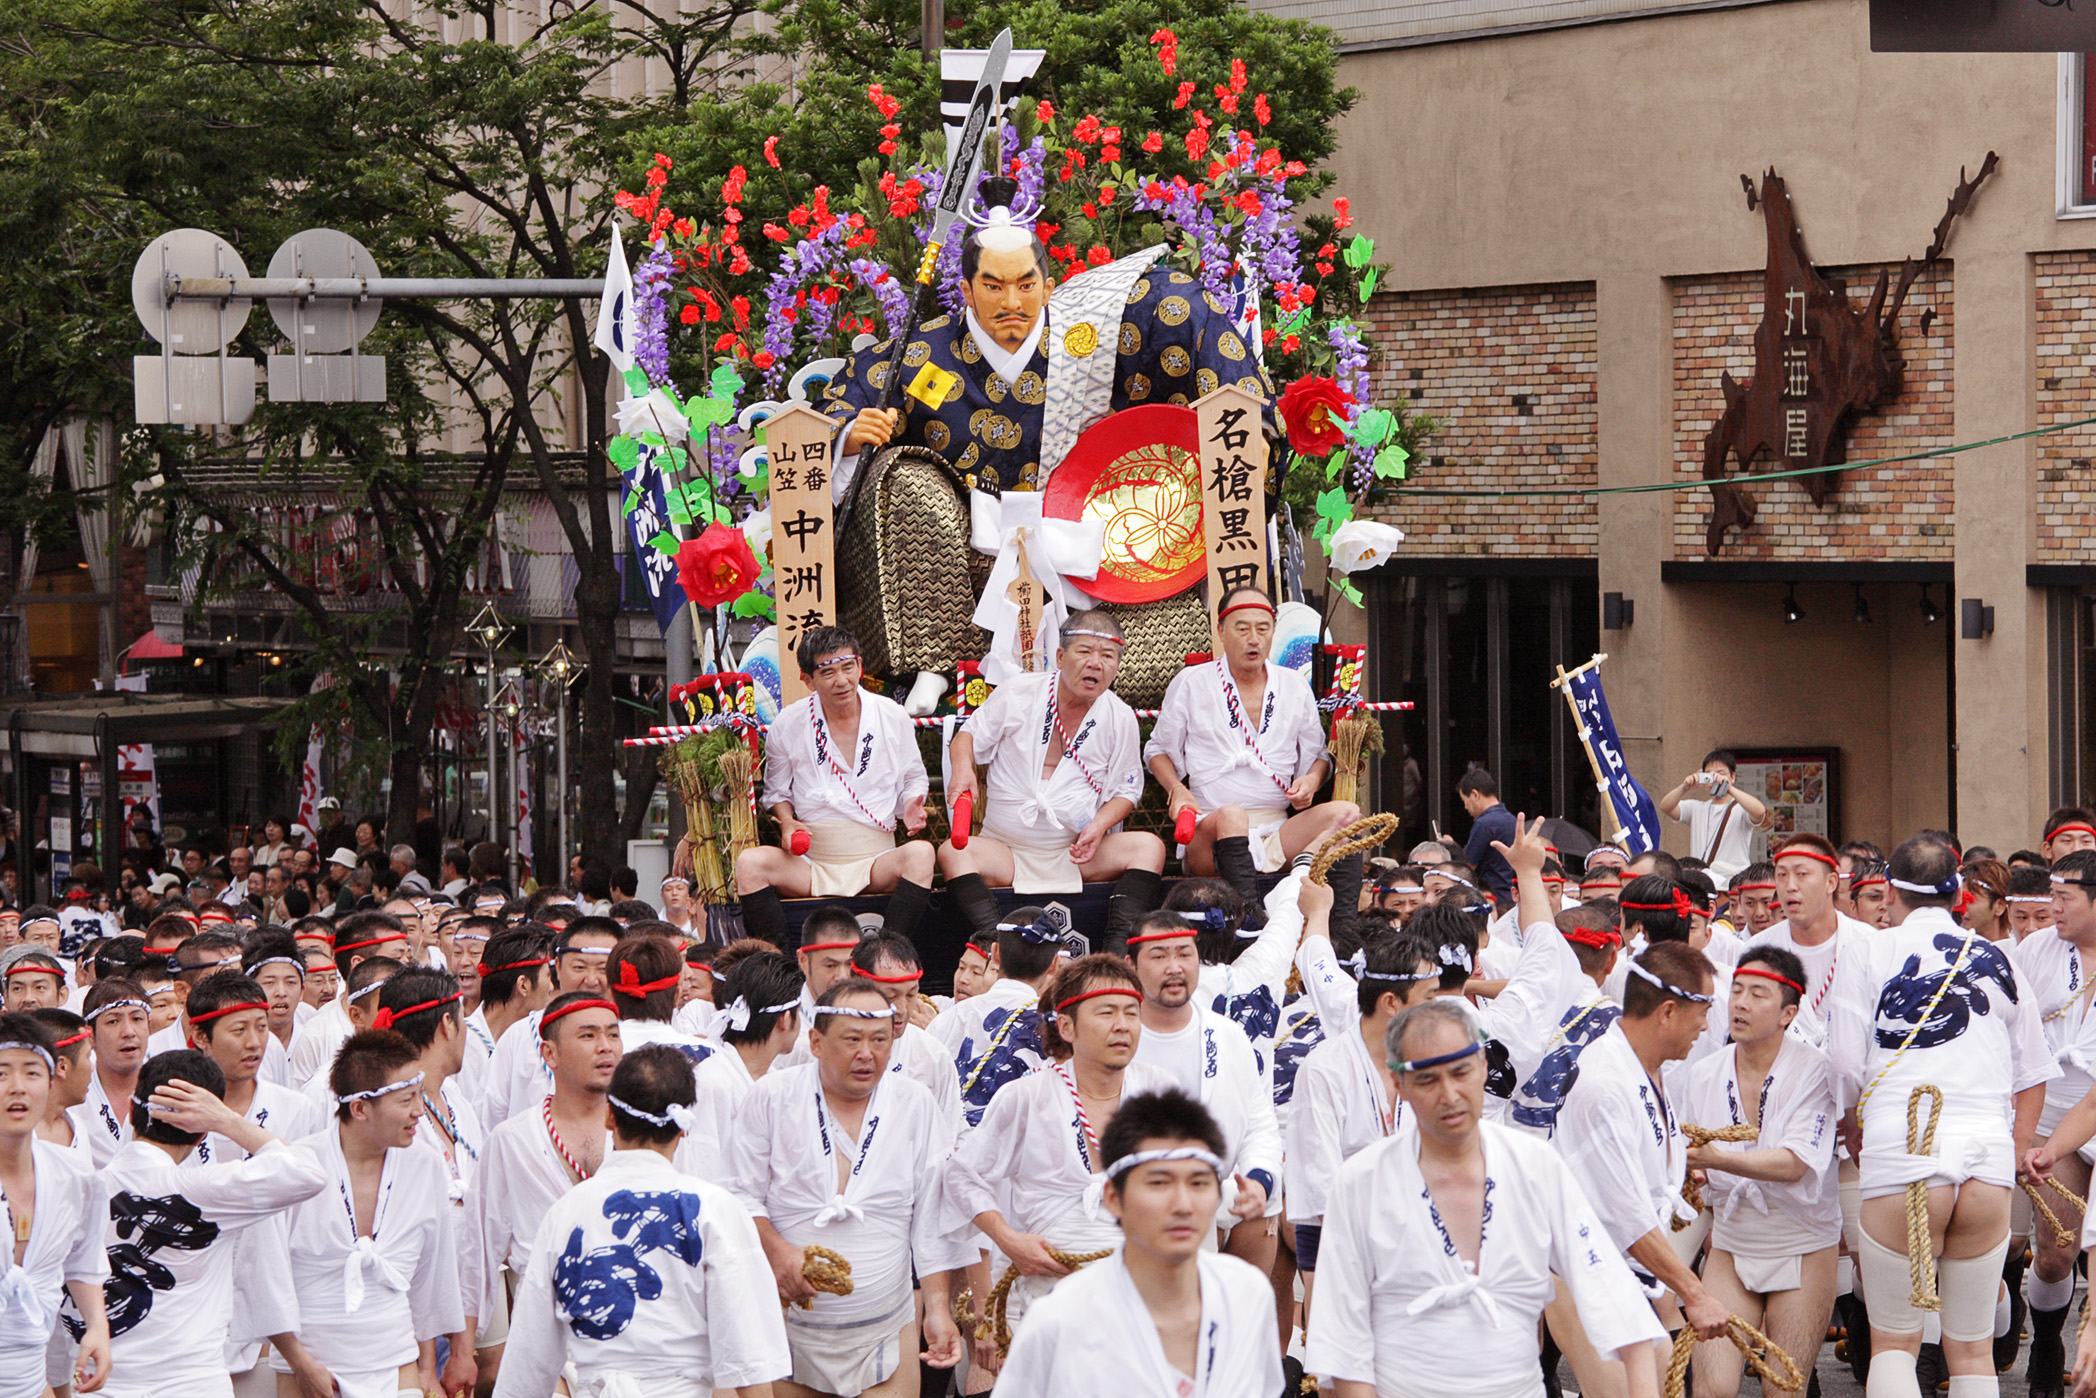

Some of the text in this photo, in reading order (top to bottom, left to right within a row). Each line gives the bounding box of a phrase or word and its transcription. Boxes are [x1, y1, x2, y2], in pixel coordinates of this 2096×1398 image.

[772, 441, 798, 492] 山笠
[801, 441, 828, 492] 四番
[1207, 407, 1260, 593] 名槍黒田
[780, 508, 825, 652] 中洲流
